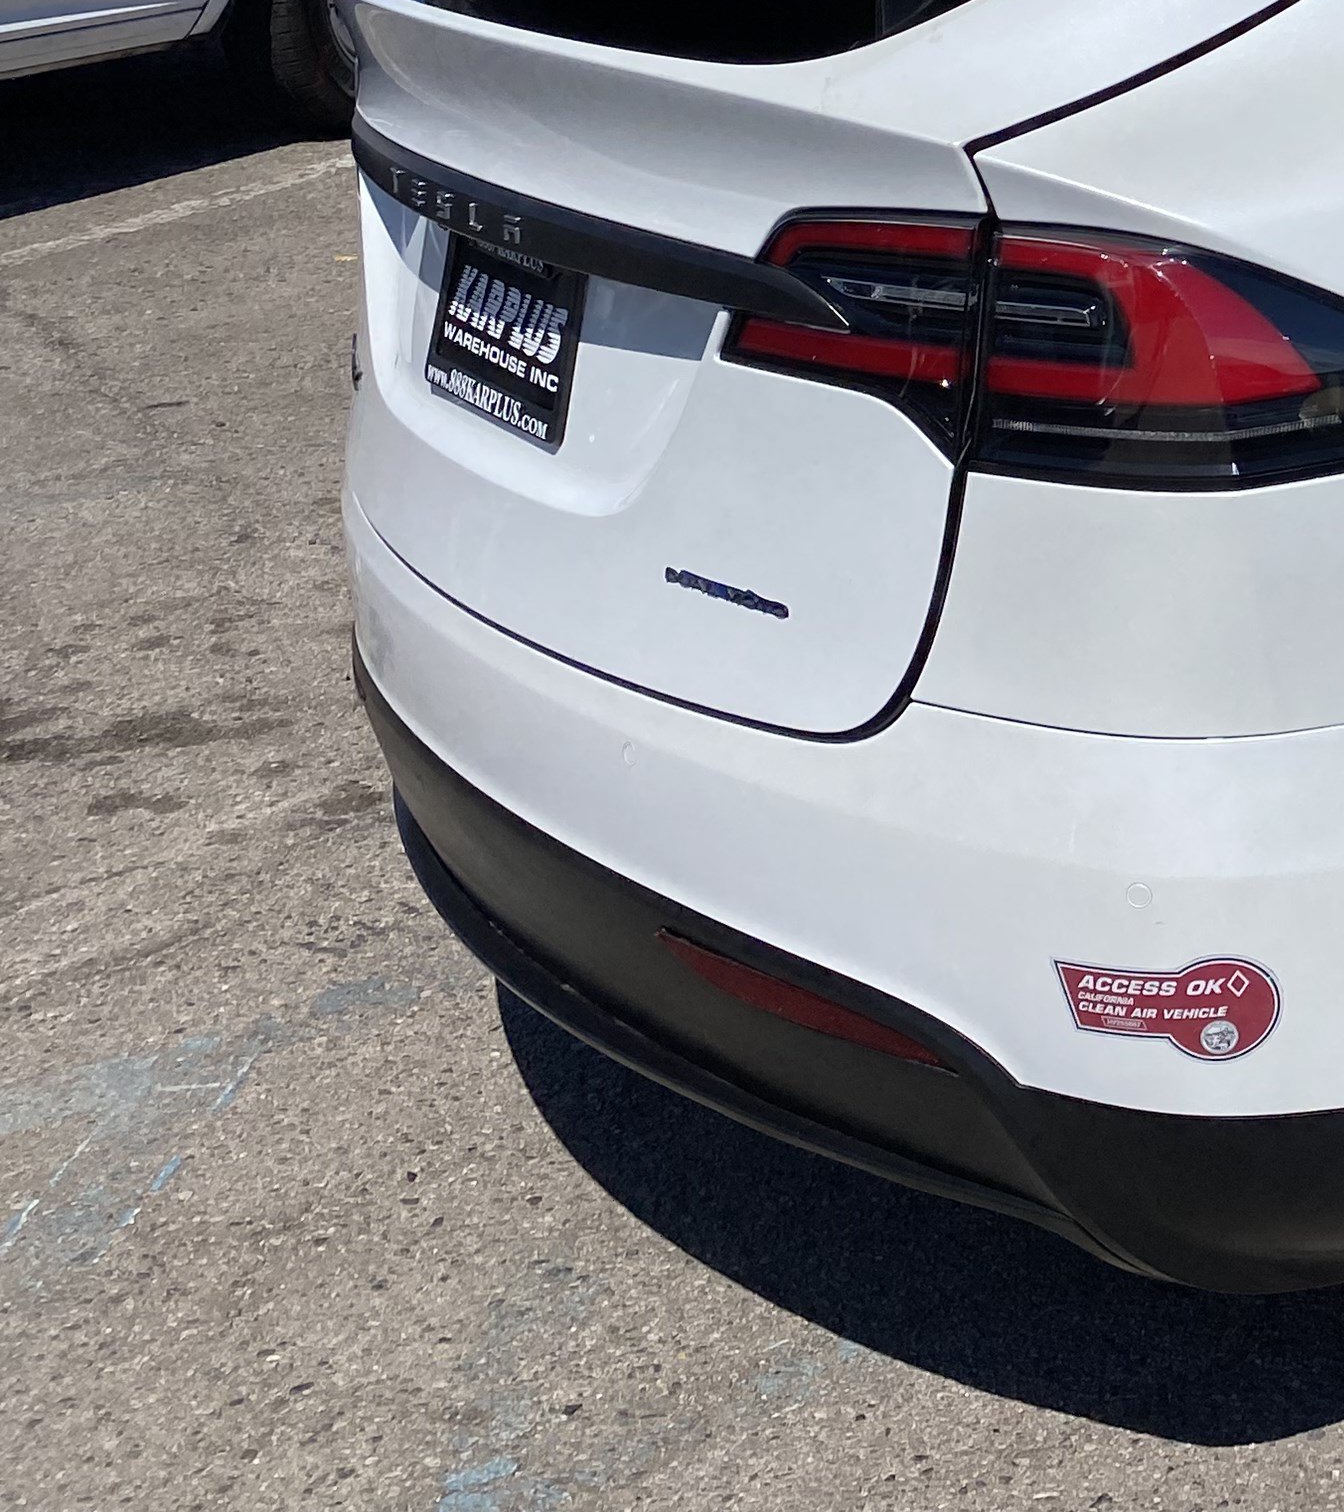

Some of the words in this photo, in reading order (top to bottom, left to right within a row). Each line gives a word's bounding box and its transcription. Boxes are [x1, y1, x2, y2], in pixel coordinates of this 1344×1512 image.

[390, 167, 521, 244] TESLA
[448, 265, 568, 364] KARPLUS
[444, 321, 527, 377] WAREHOUSE
[530, 366, 559, 392] INC
[1077, 975, 1177, 997] ACCESS
[1186, 977, 1227, 996] OK
[1077, 991, 1134, 1006] CALIFORNIA
[1078, 1001, 1128, 1017] CLEAN
[1131, 1007, 1158, 1019] AIR
[1163, 1006, 1228, 1020] VEHICLE
